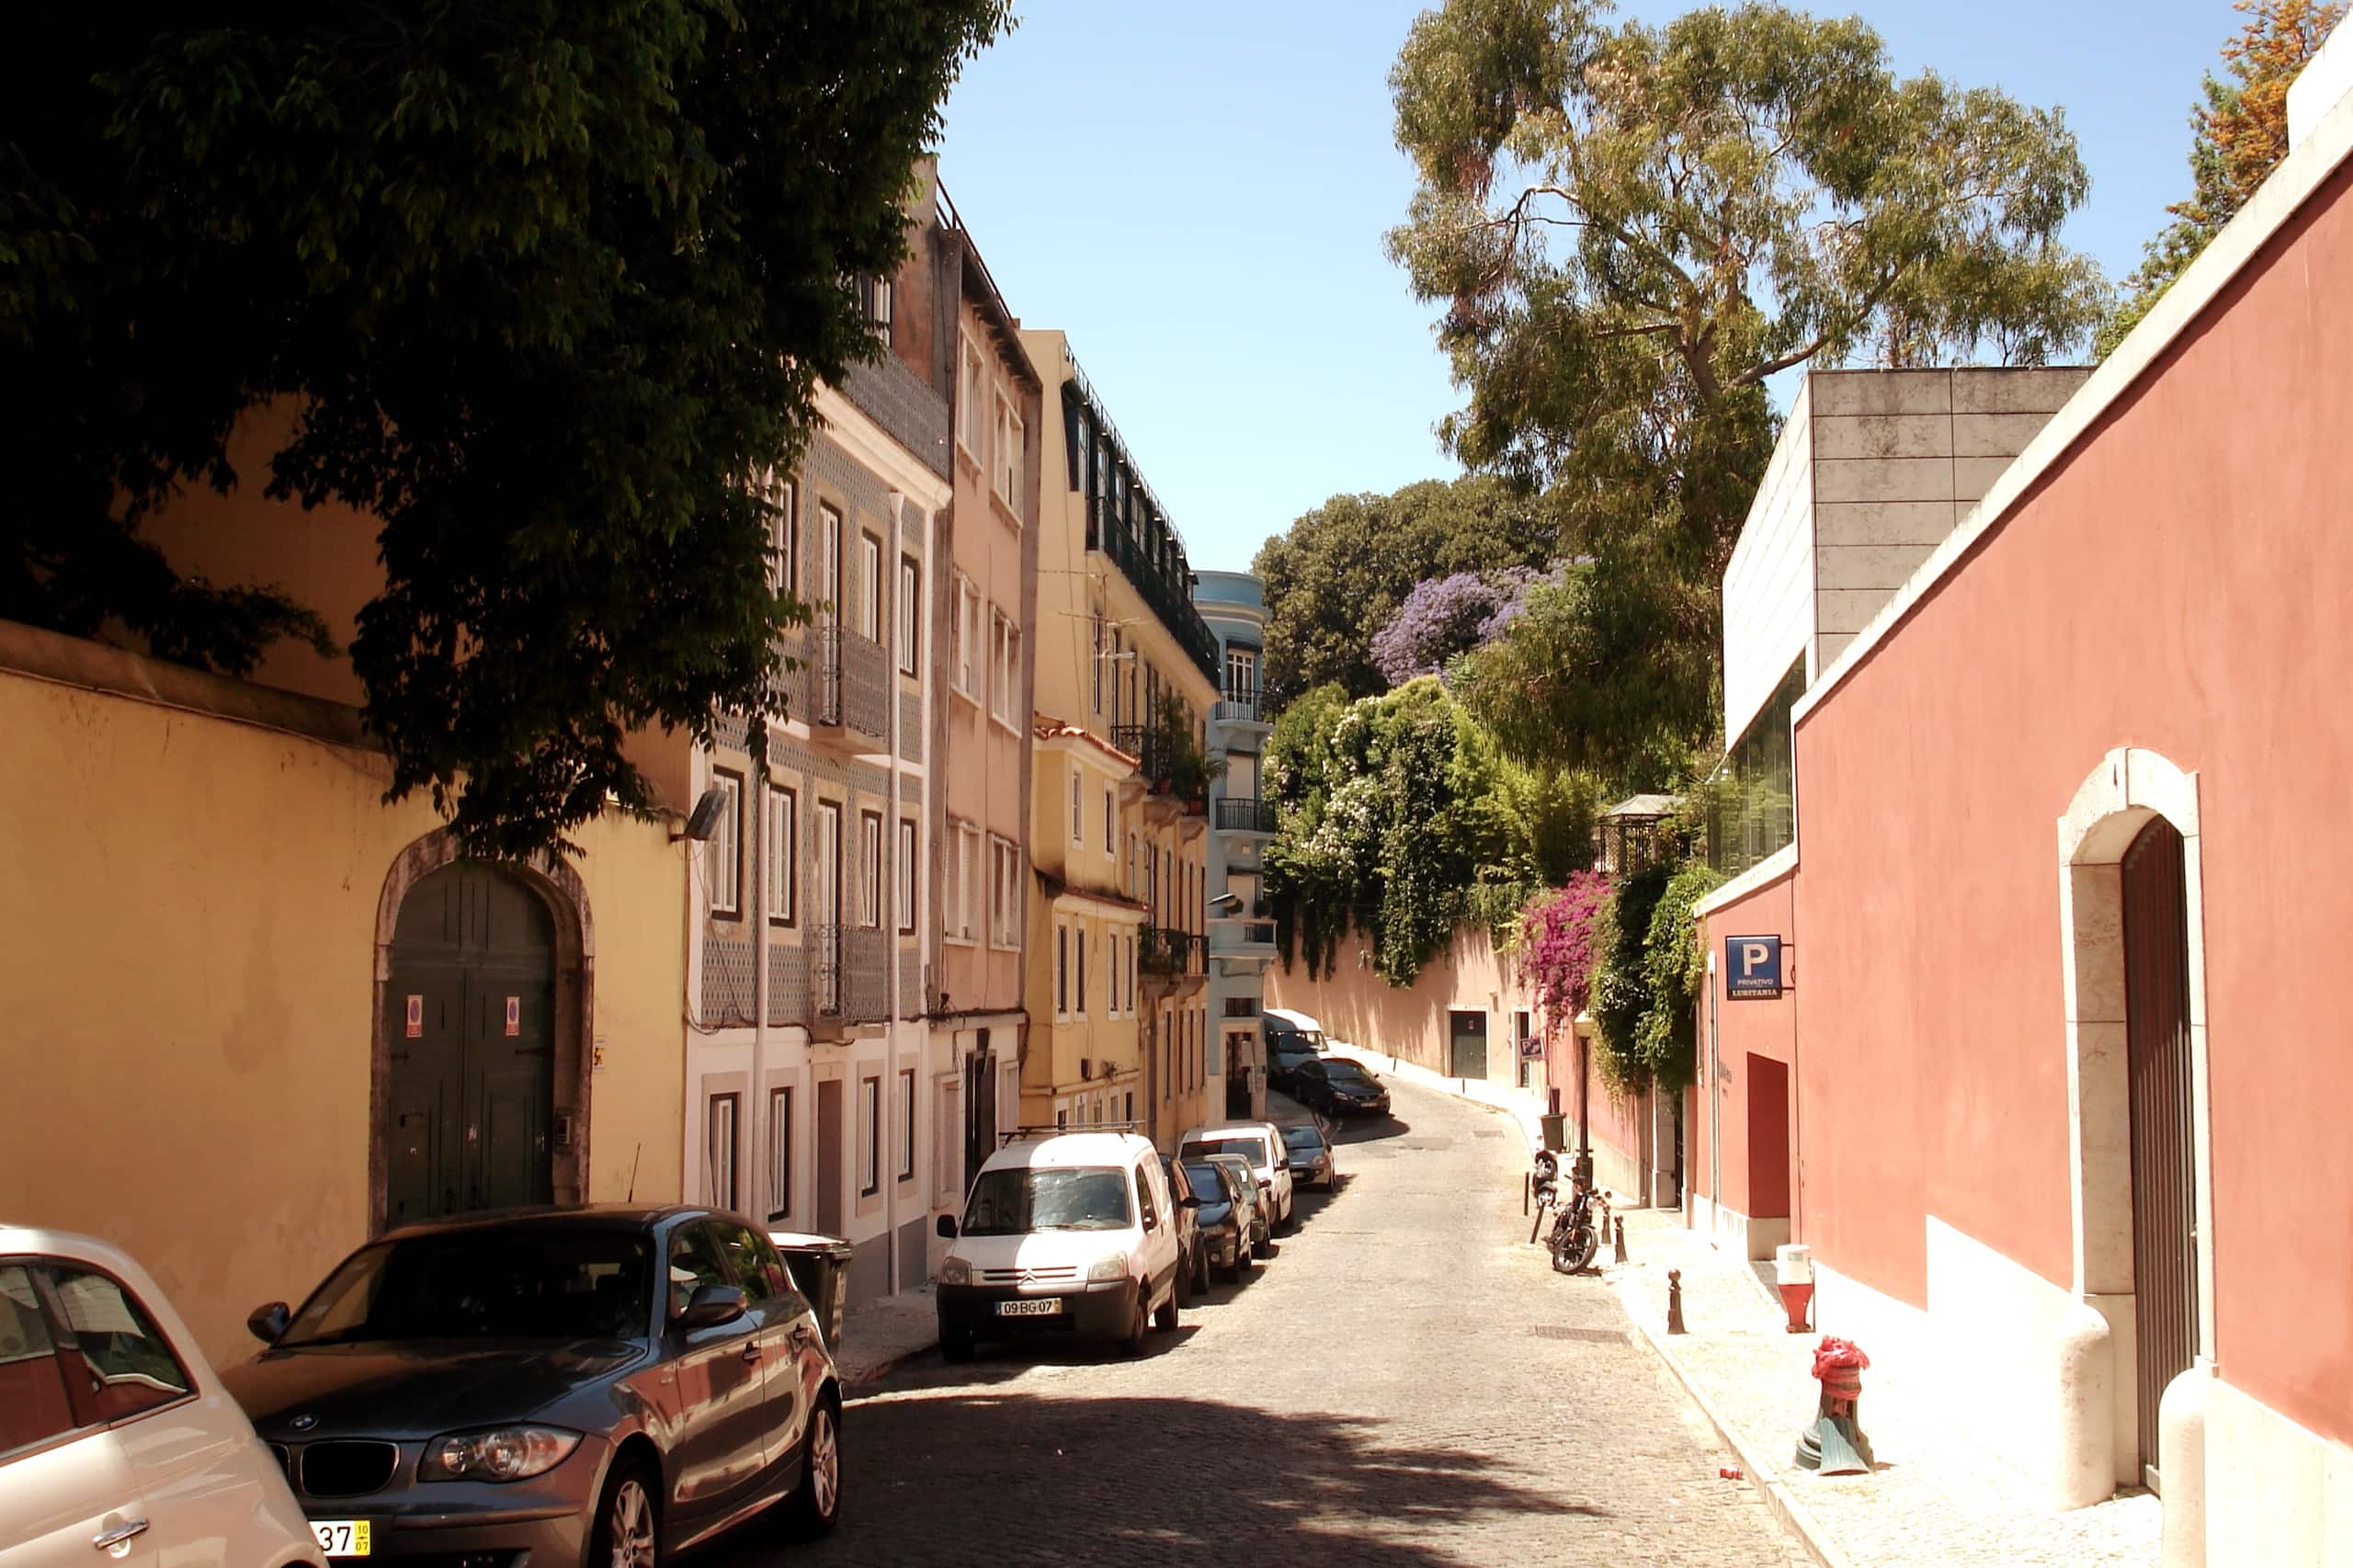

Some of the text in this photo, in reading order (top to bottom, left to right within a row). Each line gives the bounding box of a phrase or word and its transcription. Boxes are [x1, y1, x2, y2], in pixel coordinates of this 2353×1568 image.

[1743, 943, 1768, 976] P
[1736, 978, 1774, 986] PRIVATIVO
[1732, 988, 1779, 997] LUSITANIA
[358, 1525, 369, 1535] 10
[319, 1526, 351, 1551] 37
[355, 1541, 369, 1551] 07
